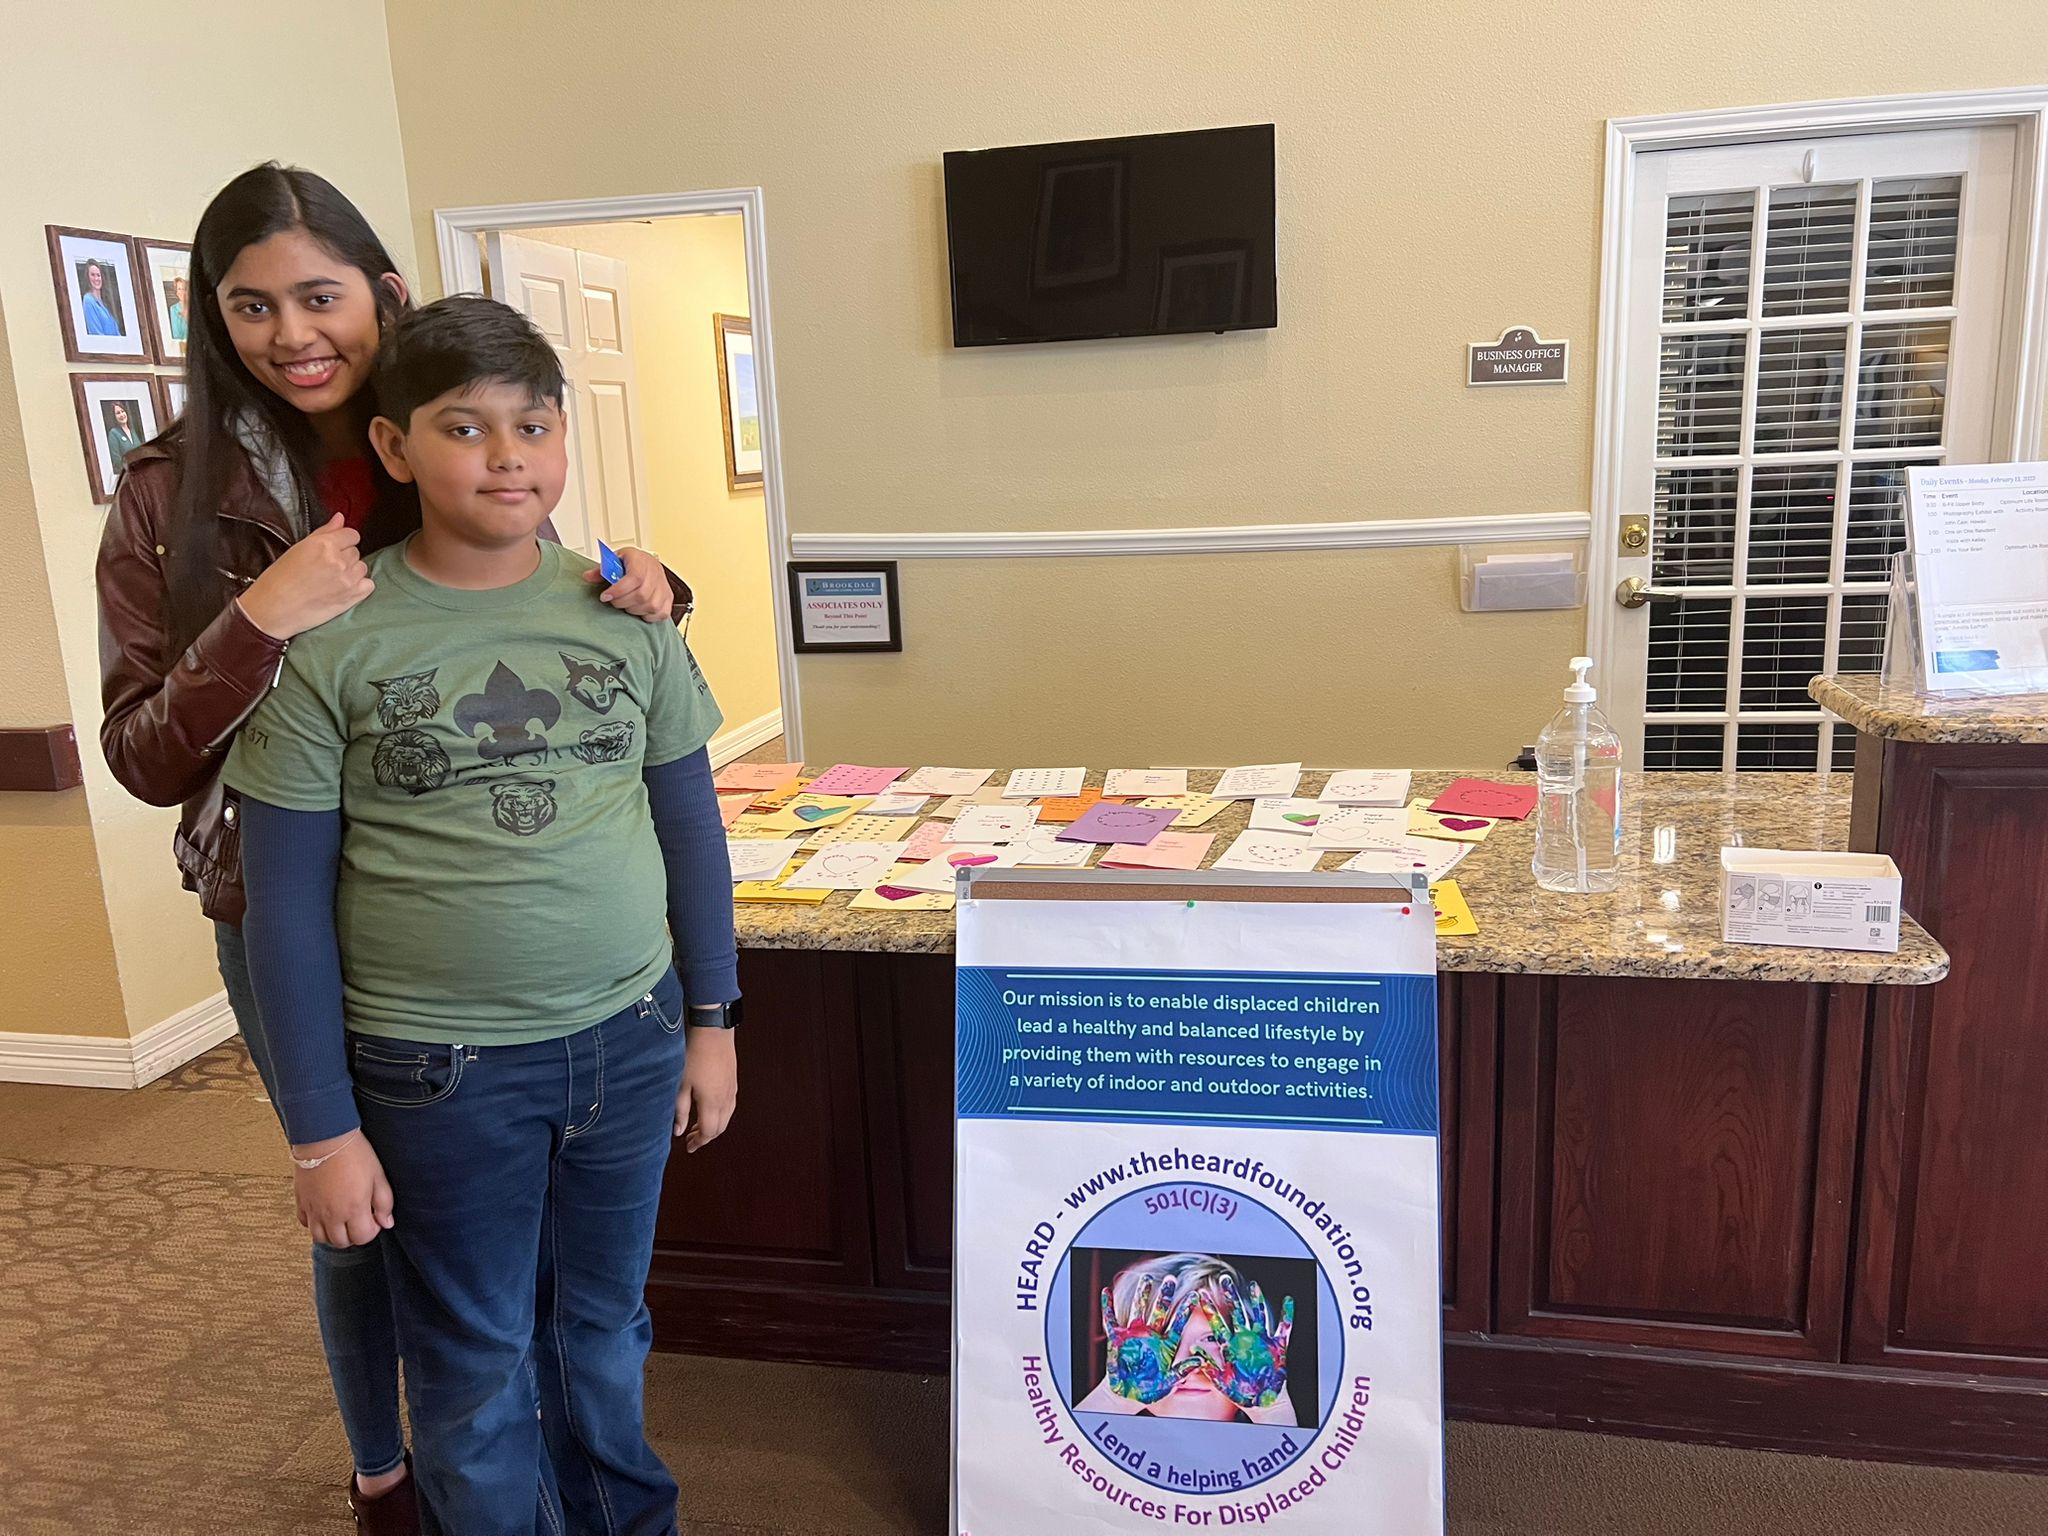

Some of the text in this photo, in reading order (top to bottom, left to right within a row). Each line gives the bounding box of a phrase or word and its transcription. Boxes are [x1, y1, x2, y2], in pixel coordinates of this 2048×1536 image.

[1477, 348, 1560, 361] BUSINESS OFFICE
[1493, 363, 1543, 374] MANAGER
[1920, 478, 1937, 487] Daily
[1939, 477, 1963, 485] Events
[859, 601, 883, 609] ONLY
[1002, 990, 1380, 1015] Our mission is to enable displaced children
[1017, 1017, 1365, 1046] lead a healthy and balanced lifestyle by
[1002, 1045, 1381, 1075] providing them with resources to engage in
[1009, 1073, 1373, 1099] a variety of indoor and outdoor activities.
[1144, 1189, 1239, 1221] 501(C)(3)
[1017, 1221, 1056, 1311] HEARD
[1064, 1147, 1373, 1331] www.theheardfoundation.org
[1022, 1355, 1371, 1526] Healthy Resources For Displaced Children
[1093, 1420, 1300, 1491] Lend a helping hand
